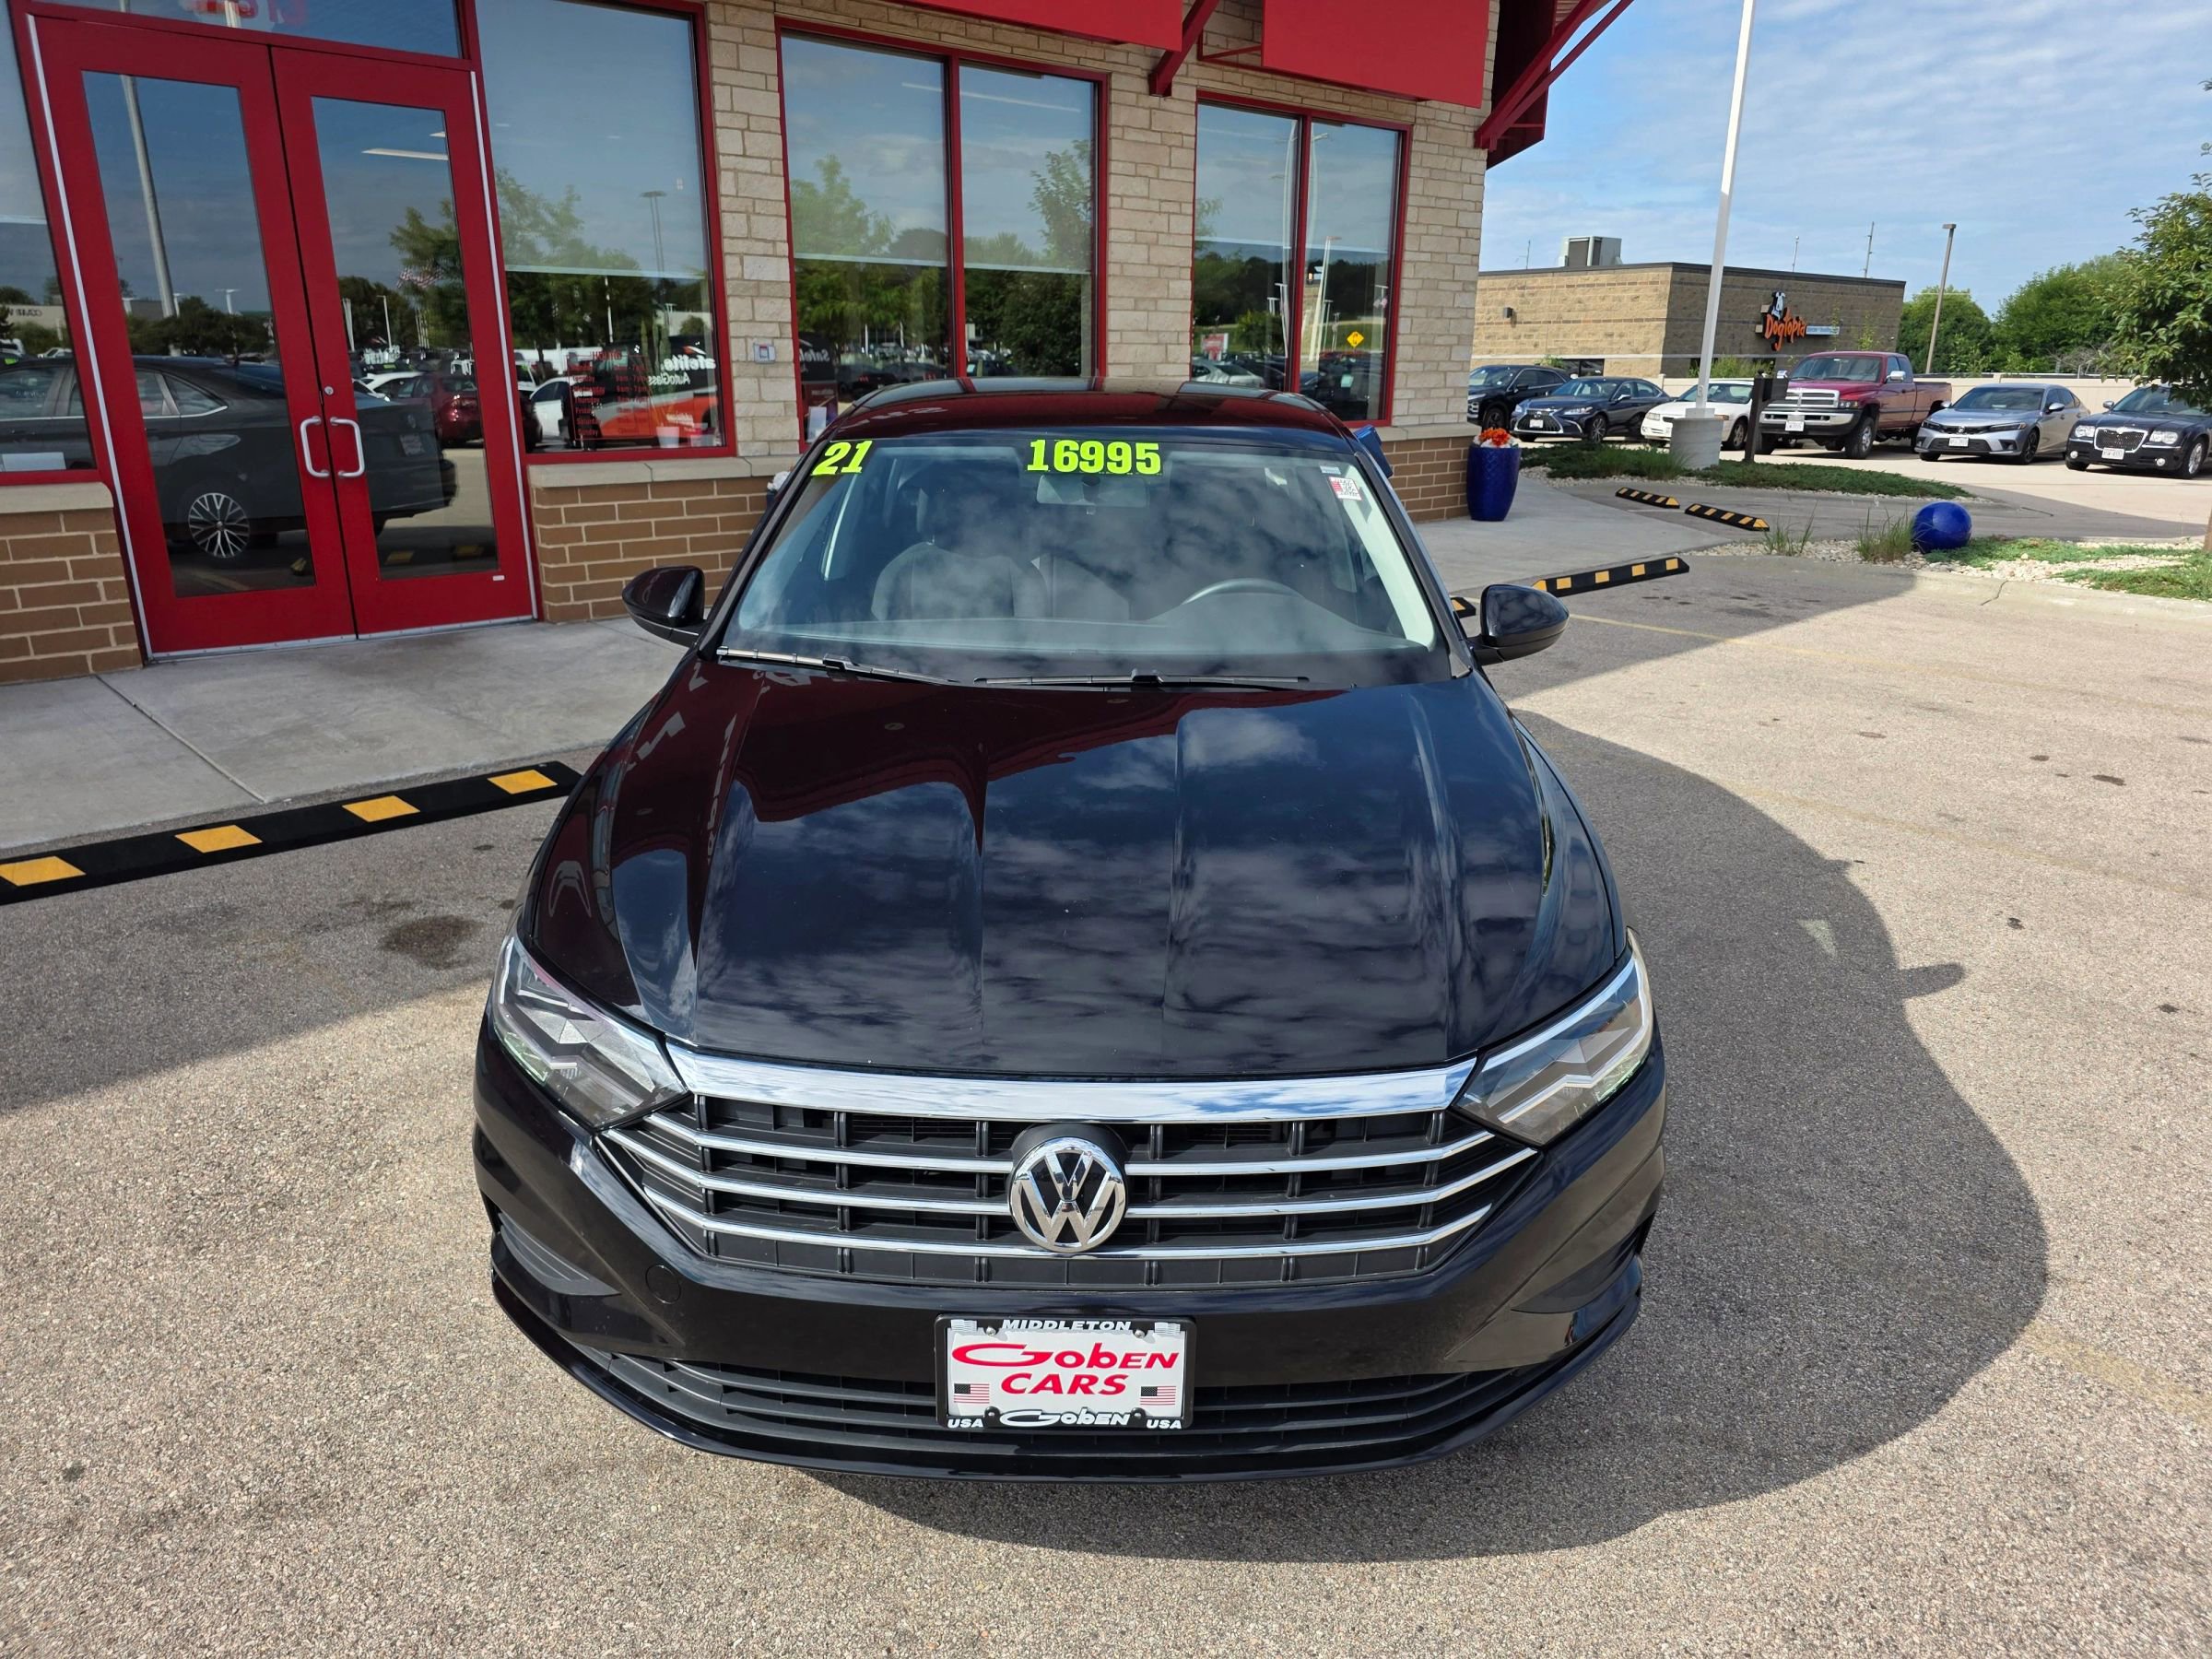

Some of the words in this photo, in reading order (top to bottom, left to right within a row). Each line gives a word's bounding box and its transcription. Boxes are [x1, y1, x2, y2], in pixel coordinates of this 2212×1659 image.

[1764, 306, 1806, 351] Dogtopia
[811, 441, 873, 476] 21
[1027, 439, 1161, 475] 16995
[1002, 1319, 1131, 1332] MIDDLETON
[1001, 1372, 1129, 1395] CARS
[947, 1418, 983, 1429] USA
[1146, 1418, 1182, 1430] USA
